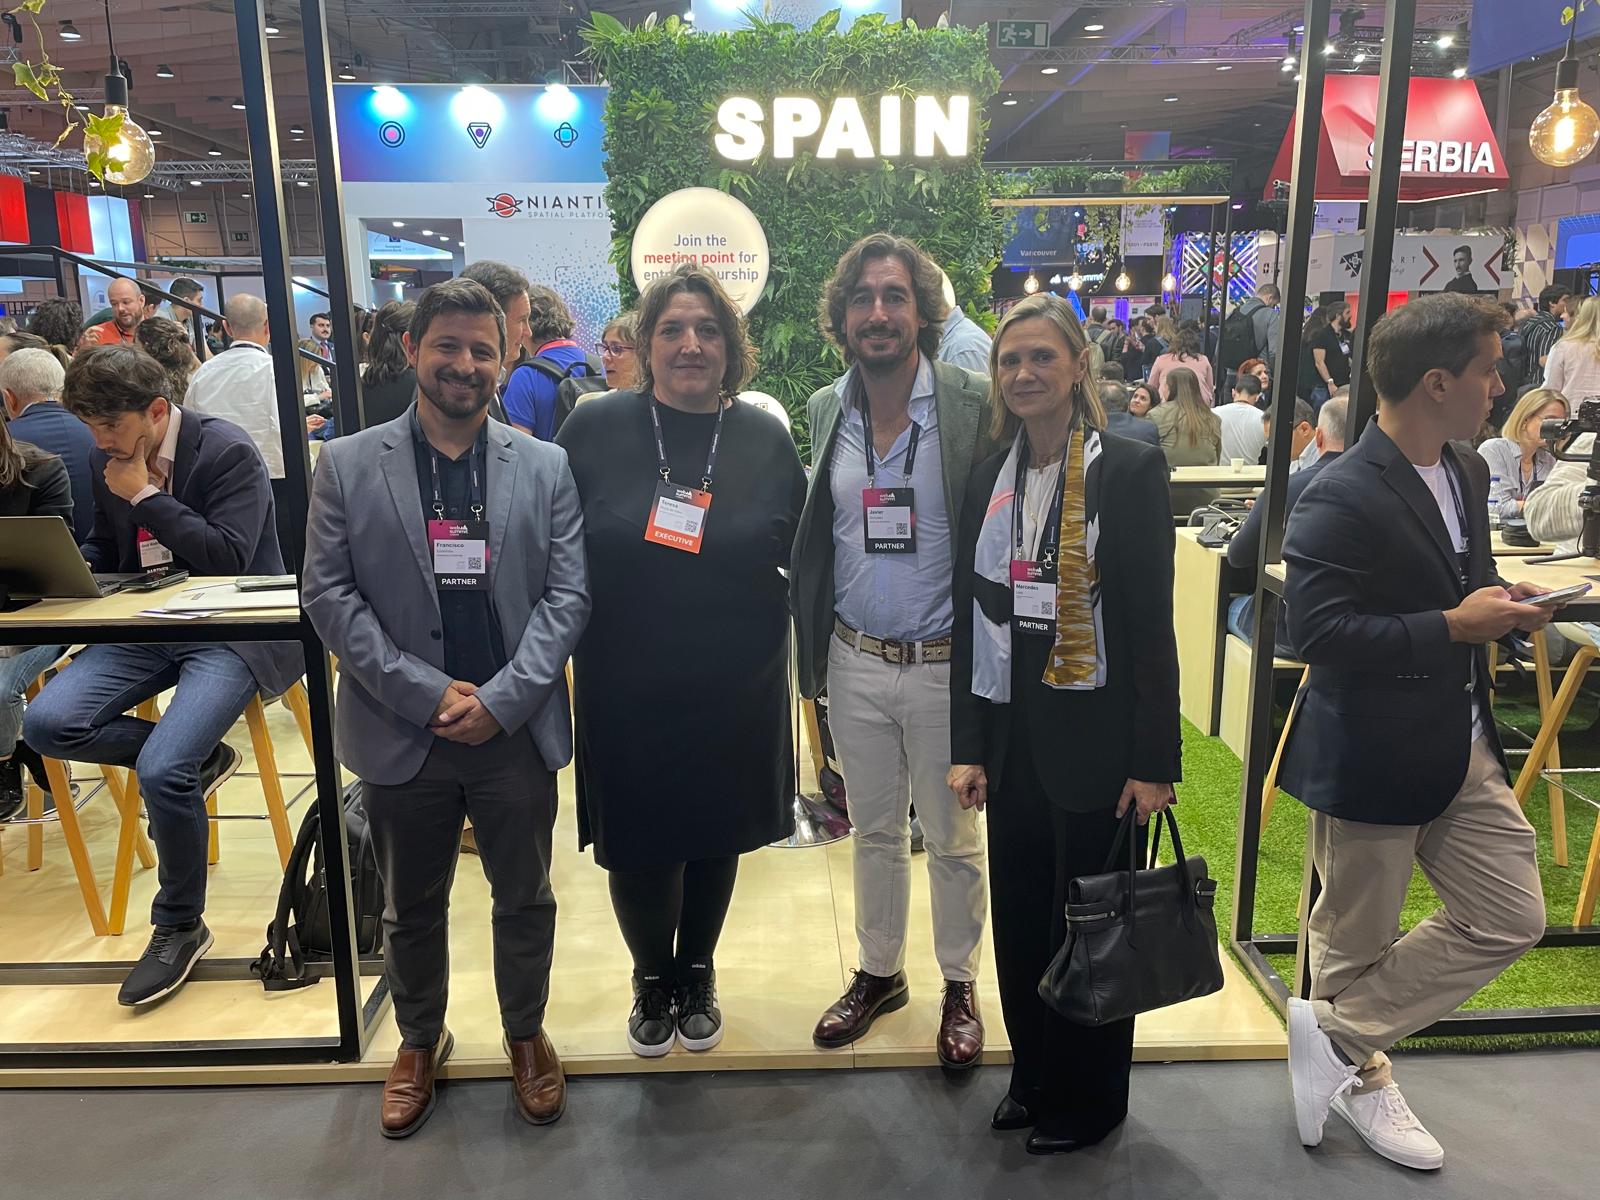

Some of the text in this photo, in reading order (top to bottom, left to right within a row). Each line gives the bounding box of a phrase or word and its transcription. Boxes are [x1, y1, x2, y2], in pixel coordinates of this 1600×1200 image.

[714, 95, 970, 161] SPAIN
[527, 195, 602, 209] NIANTI
[673, 233, 728, 247] Join the
[643, 250, 758, 266] meeting point for
[1020, 249, 1057, 257] Vancouver
[655, 531, 694, 546] EXECUTIVE
[874, 542, 905, 550] PARTNER
[1016, 583, 1039, 591] Mercedes
[1019, 620, 1049, 631] PARTNER
